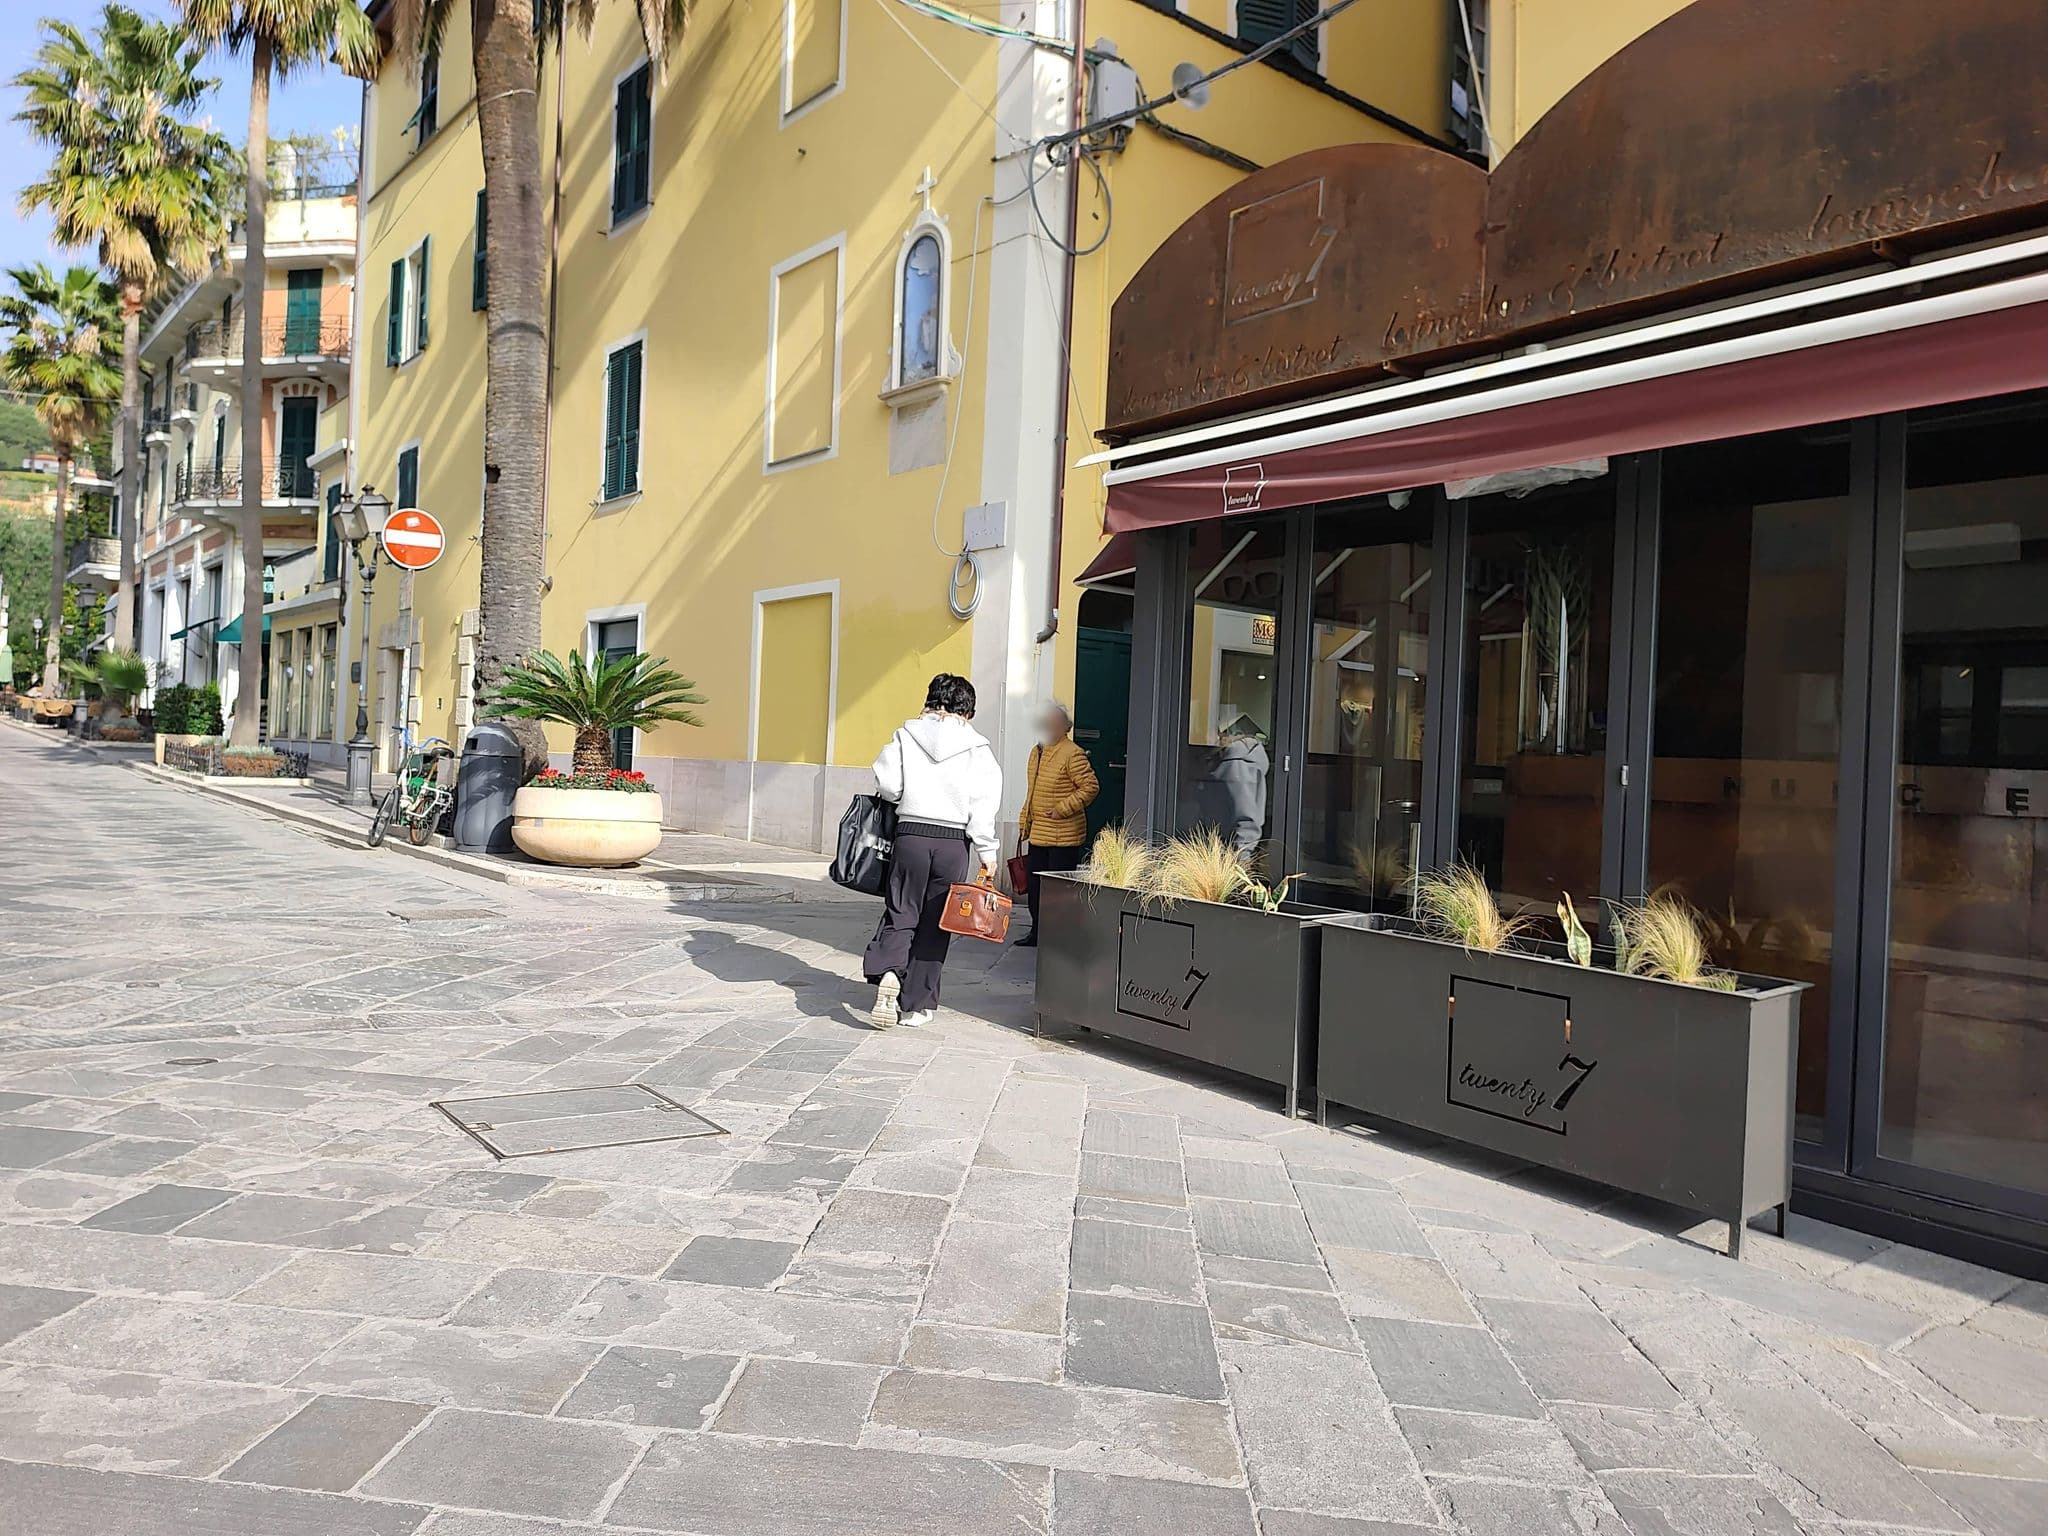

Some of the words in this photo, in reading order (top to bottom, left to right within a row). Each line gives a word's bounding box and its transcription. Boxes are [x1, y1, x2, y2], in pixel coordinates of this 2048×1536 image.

[1304, 225, 1338, 283] 7
[1254, 479, 1269, 501] 7
[1124, 979, 1178, 1017] twenty
[1182, 965, 1210, 1010] 7
[1459, 1063, 1546, 1117] twenty
[1552, 1053, 1598, 1111] 7
